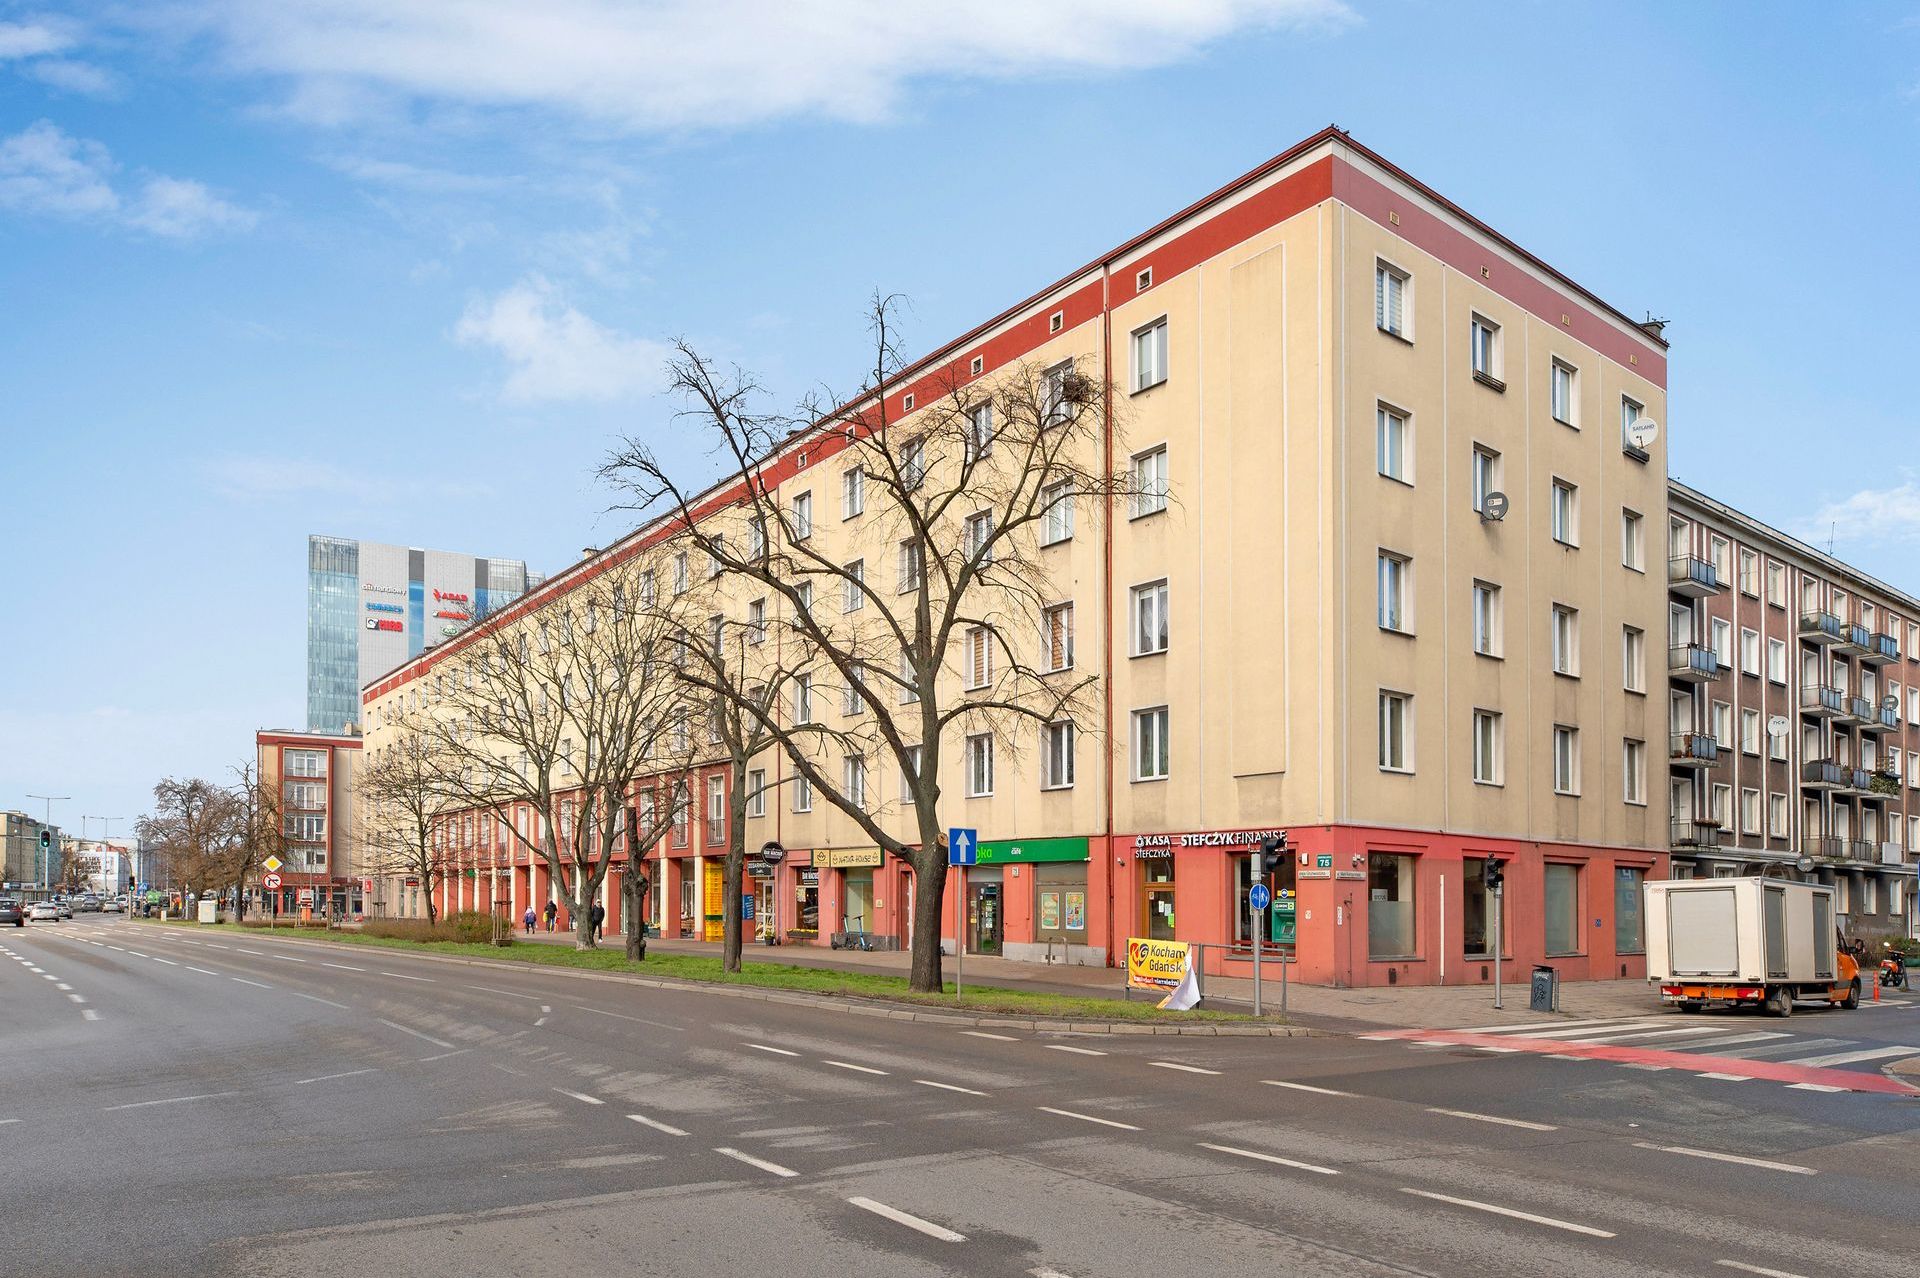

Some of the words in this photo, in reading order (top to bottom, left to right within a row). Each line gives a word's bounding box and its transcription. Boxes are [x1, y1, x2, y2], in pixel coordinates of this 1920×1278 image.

[1146, 835, 1170, 846] KASA
[1181, 832, 1234, 847] STEFCZYK
[1135, 849, 1171, 859] STEFCZYKA
[1319, 859, 1330, 867] 75
[1150, 944, 1186, 959] Kocham
[1149, 959, 1182, 973] Gdańsk
